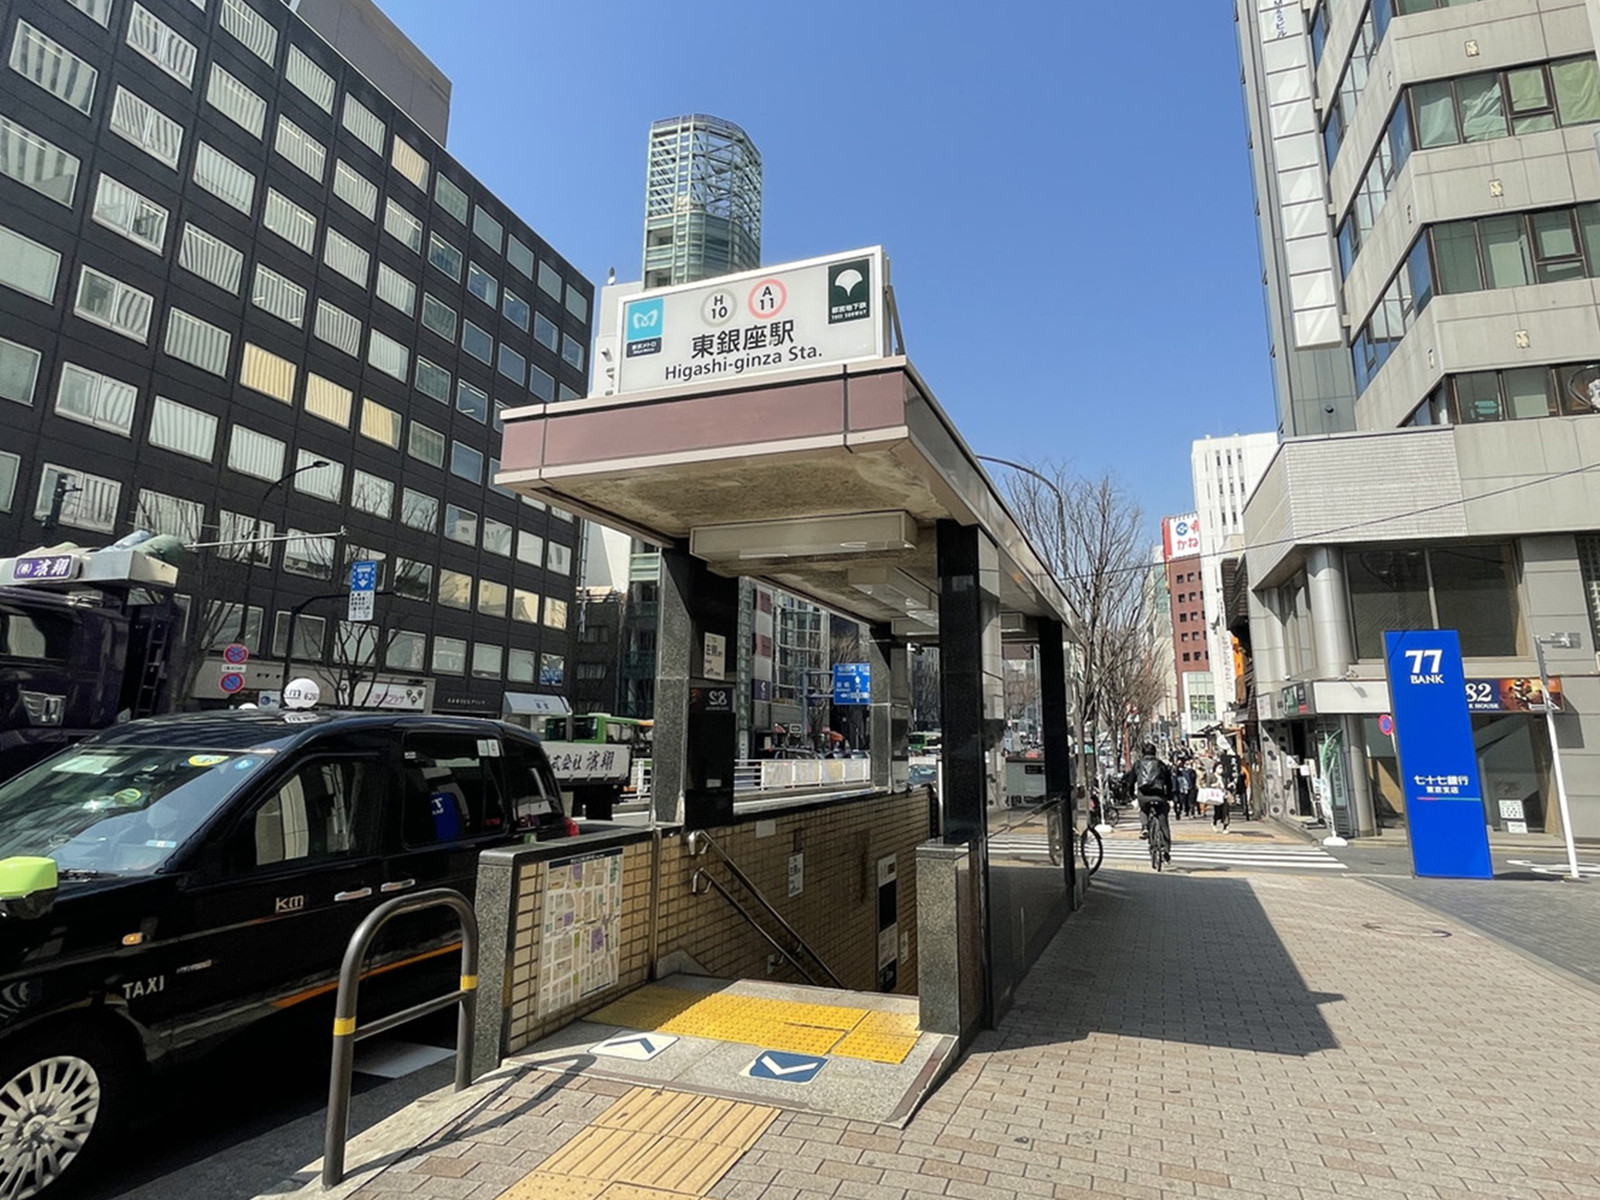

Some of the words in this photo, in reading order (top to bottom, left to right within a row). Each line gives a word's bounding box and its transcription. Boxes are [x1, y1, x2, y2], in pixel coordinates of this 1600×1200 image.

[761, 286, 772, 297] A
[713, 295, 724, 306] H
[759, 298, 775, 310] 11
[711, 306, 728, 320] 10
[691, 319, 795, 360] 東銀座駅
[665, 351, 782, 382] Higashi-ginza
[788, 346, 823, 362] Sta.
[1404, 649, 1443, 674] 77
[1410, 673, 1445, 685] BANK
[1465, 682, 1493, 702] 82
[1414, 775, 1469, 786] 七十七銀行
[122, 975, 165, 1000] TAXI
